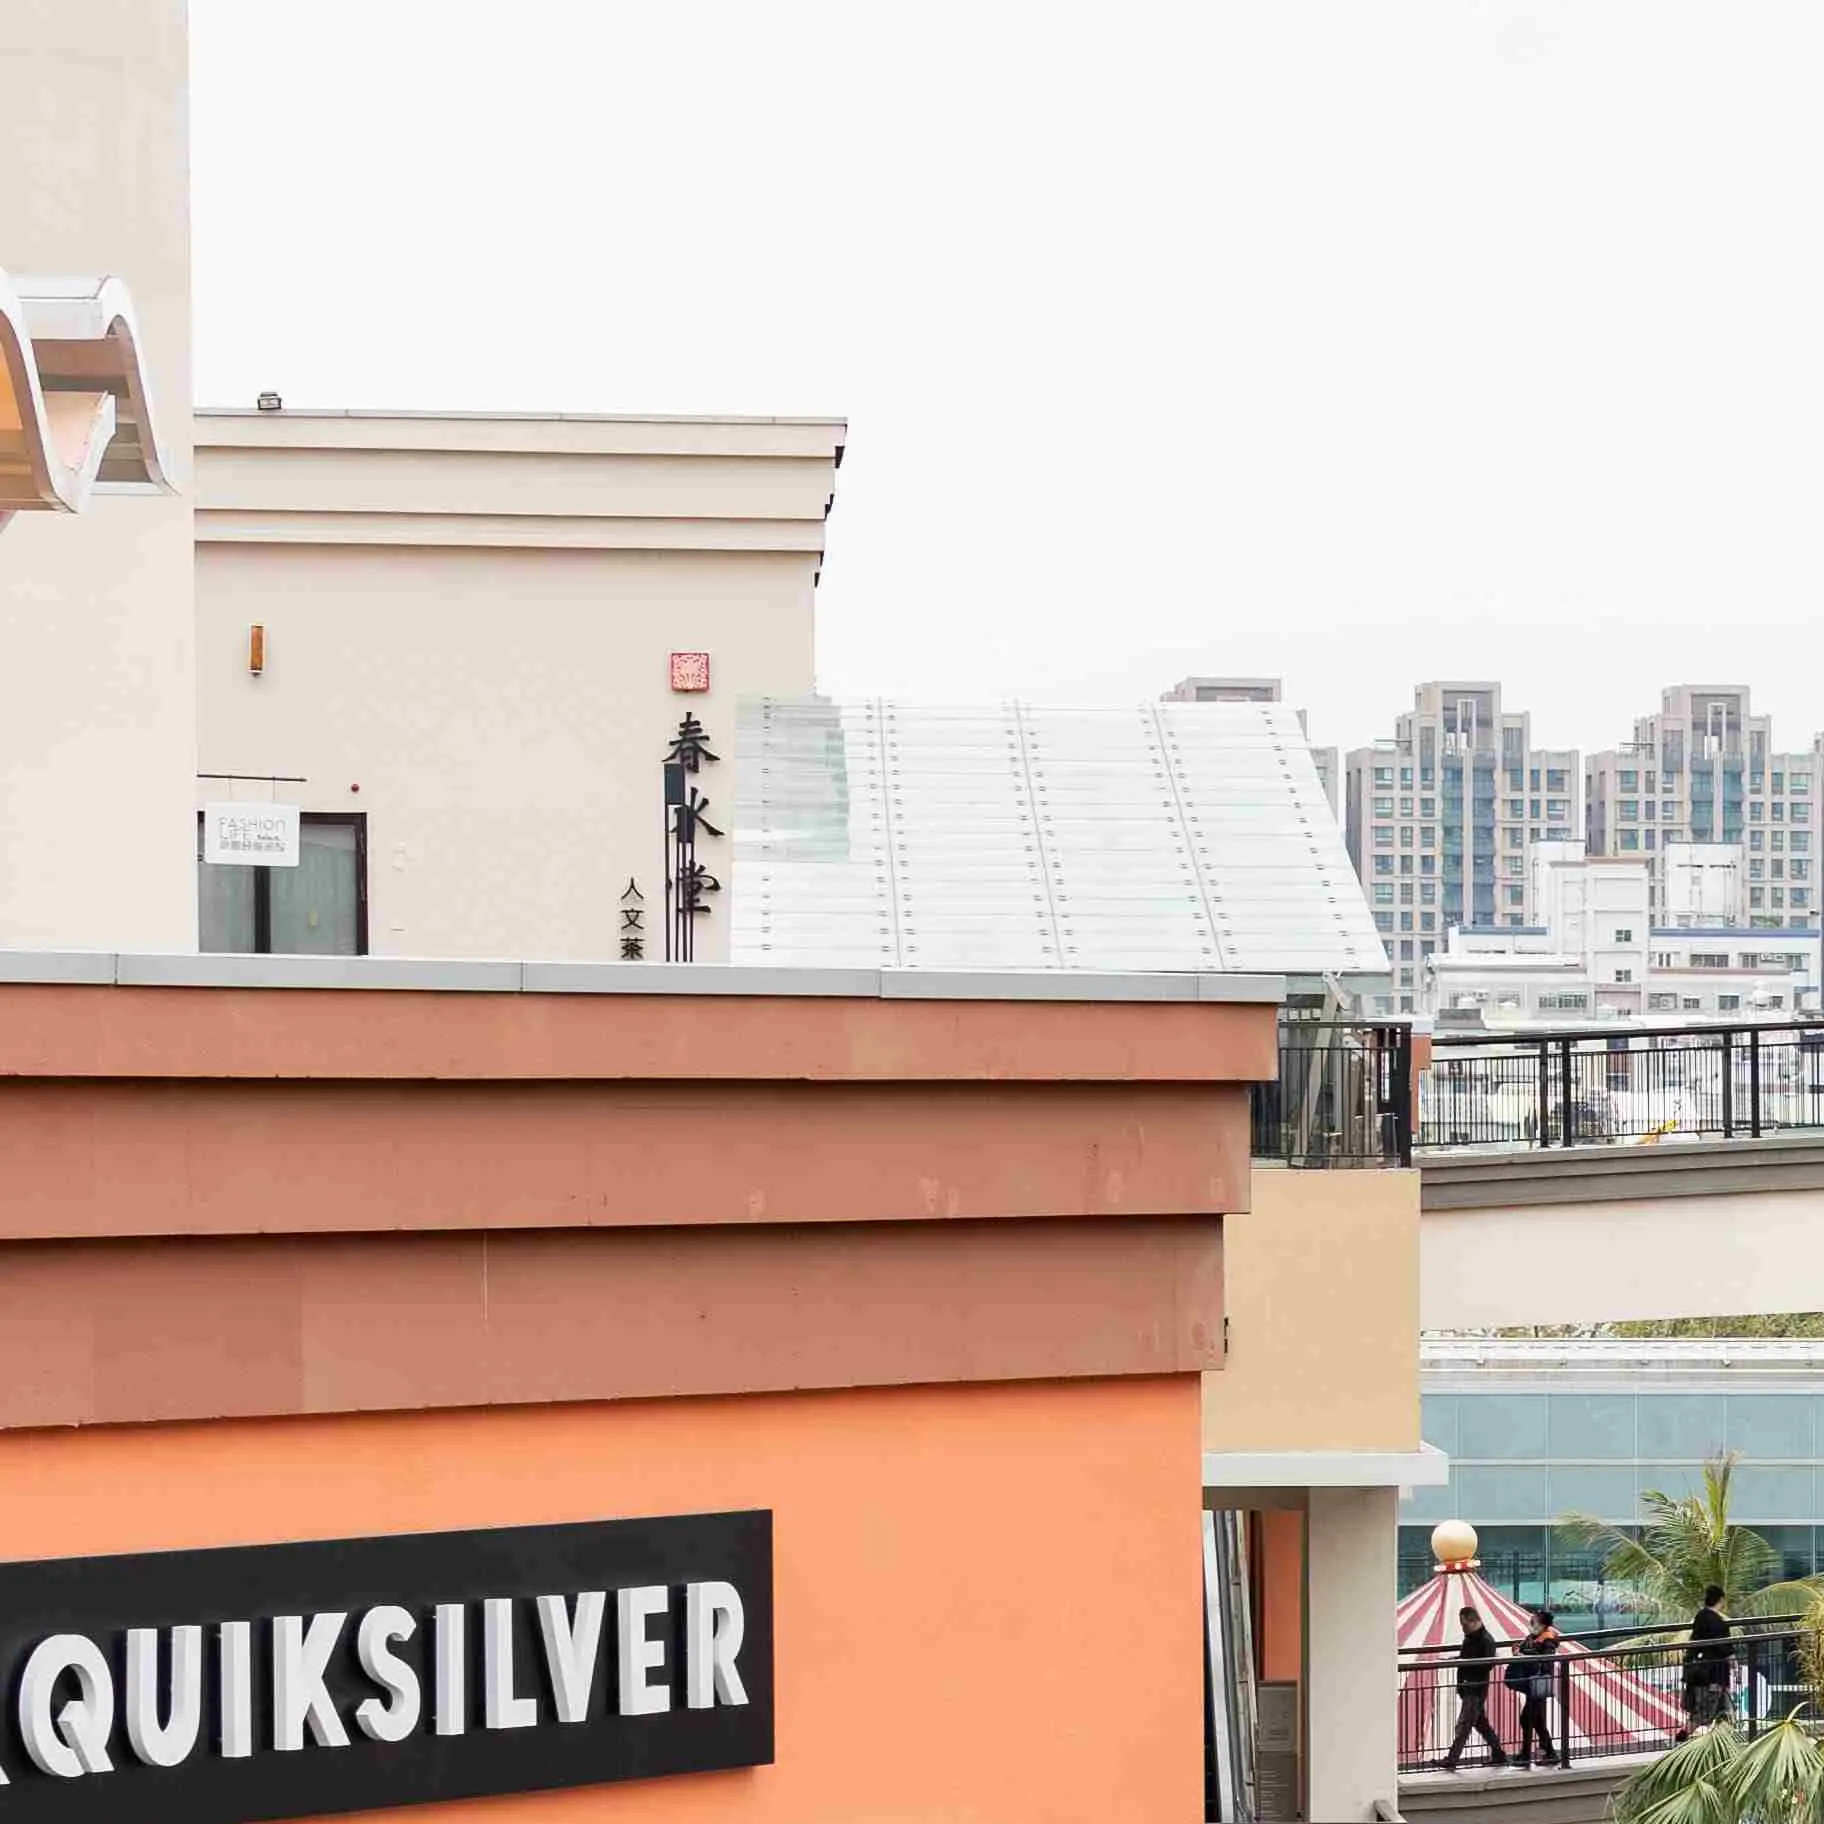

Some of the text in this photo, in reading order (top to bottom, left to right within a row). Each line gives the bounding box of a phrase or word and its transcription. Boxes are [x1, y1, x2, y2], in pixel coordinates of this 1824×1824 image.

[662, 712, 724, 913] 春水堂
[621, 877, 645, 960] 人文茶
[18, 1580, 749, 1779] QUIKSILVER
